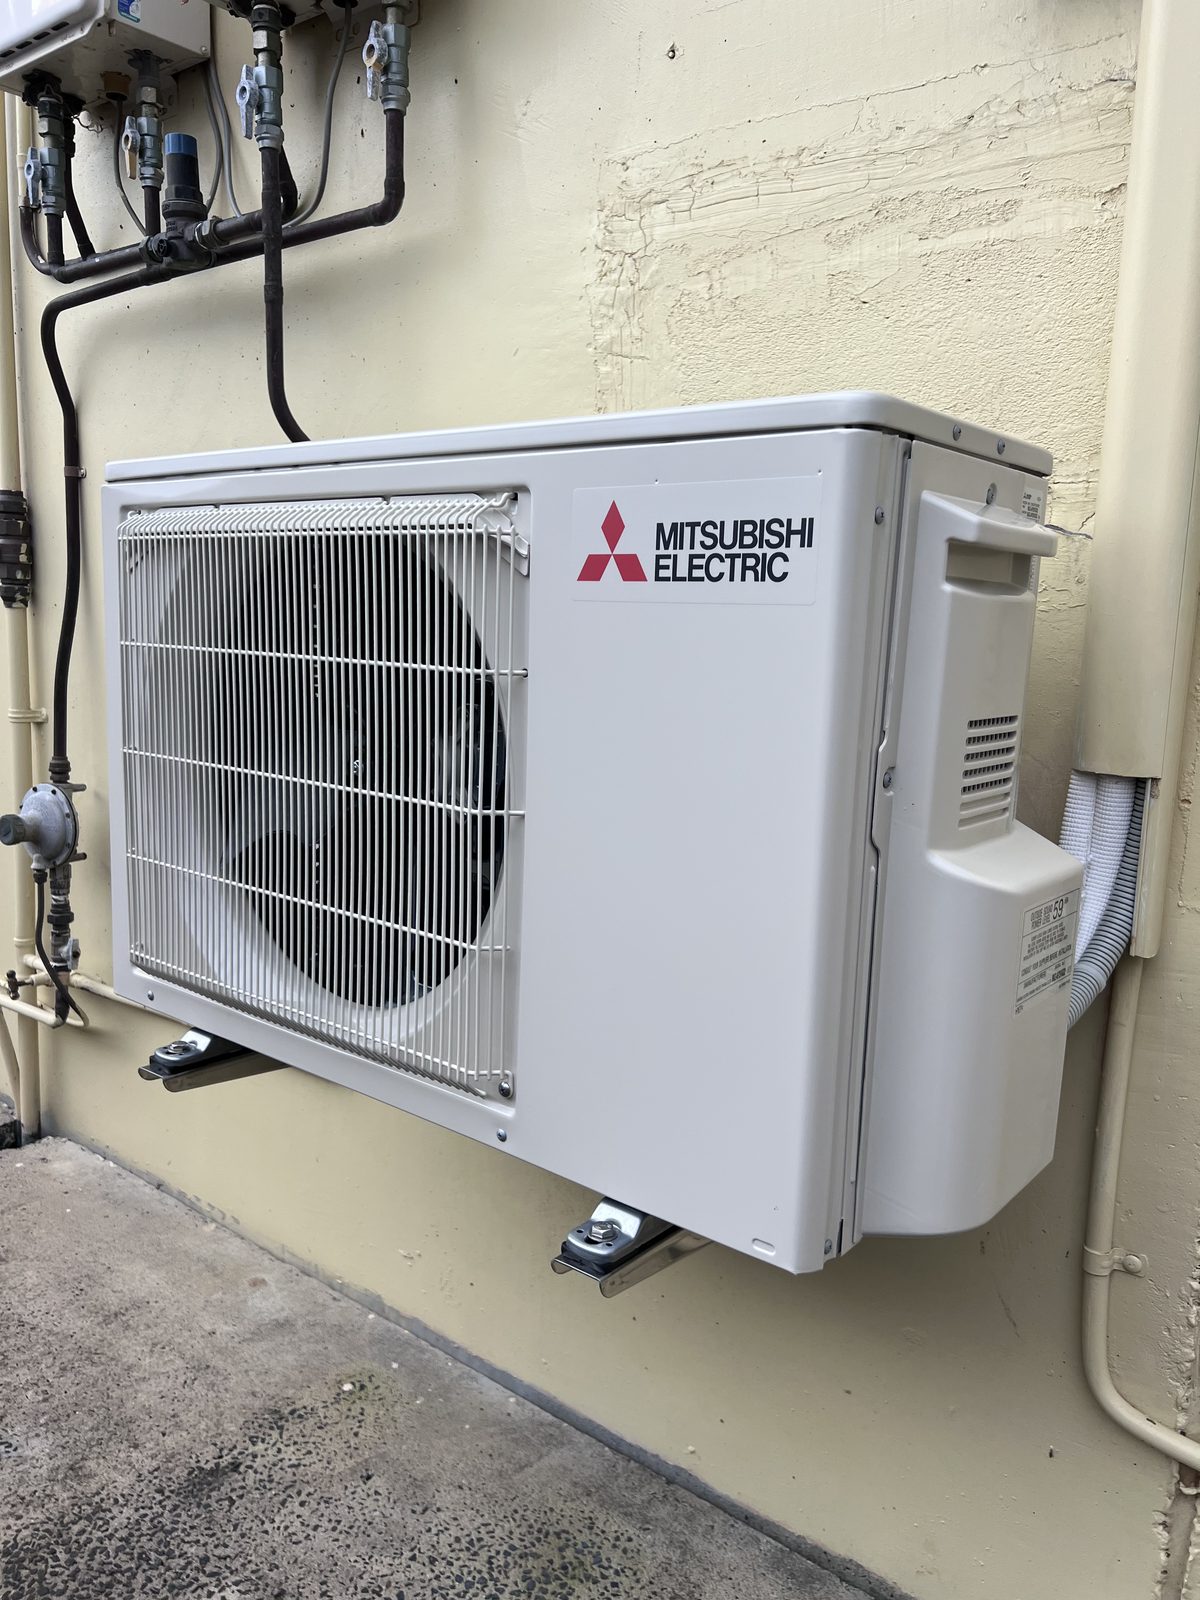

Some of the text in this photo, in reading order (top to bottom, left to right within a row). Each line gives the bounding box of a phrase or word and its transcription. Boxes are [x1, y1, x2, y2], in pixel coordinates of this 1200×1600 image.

[656, 517, 814, 550] MITSUBISHI
[654, 551, 790, 583] ELECTRIC
[1052, 898, 1064, 920] 59
